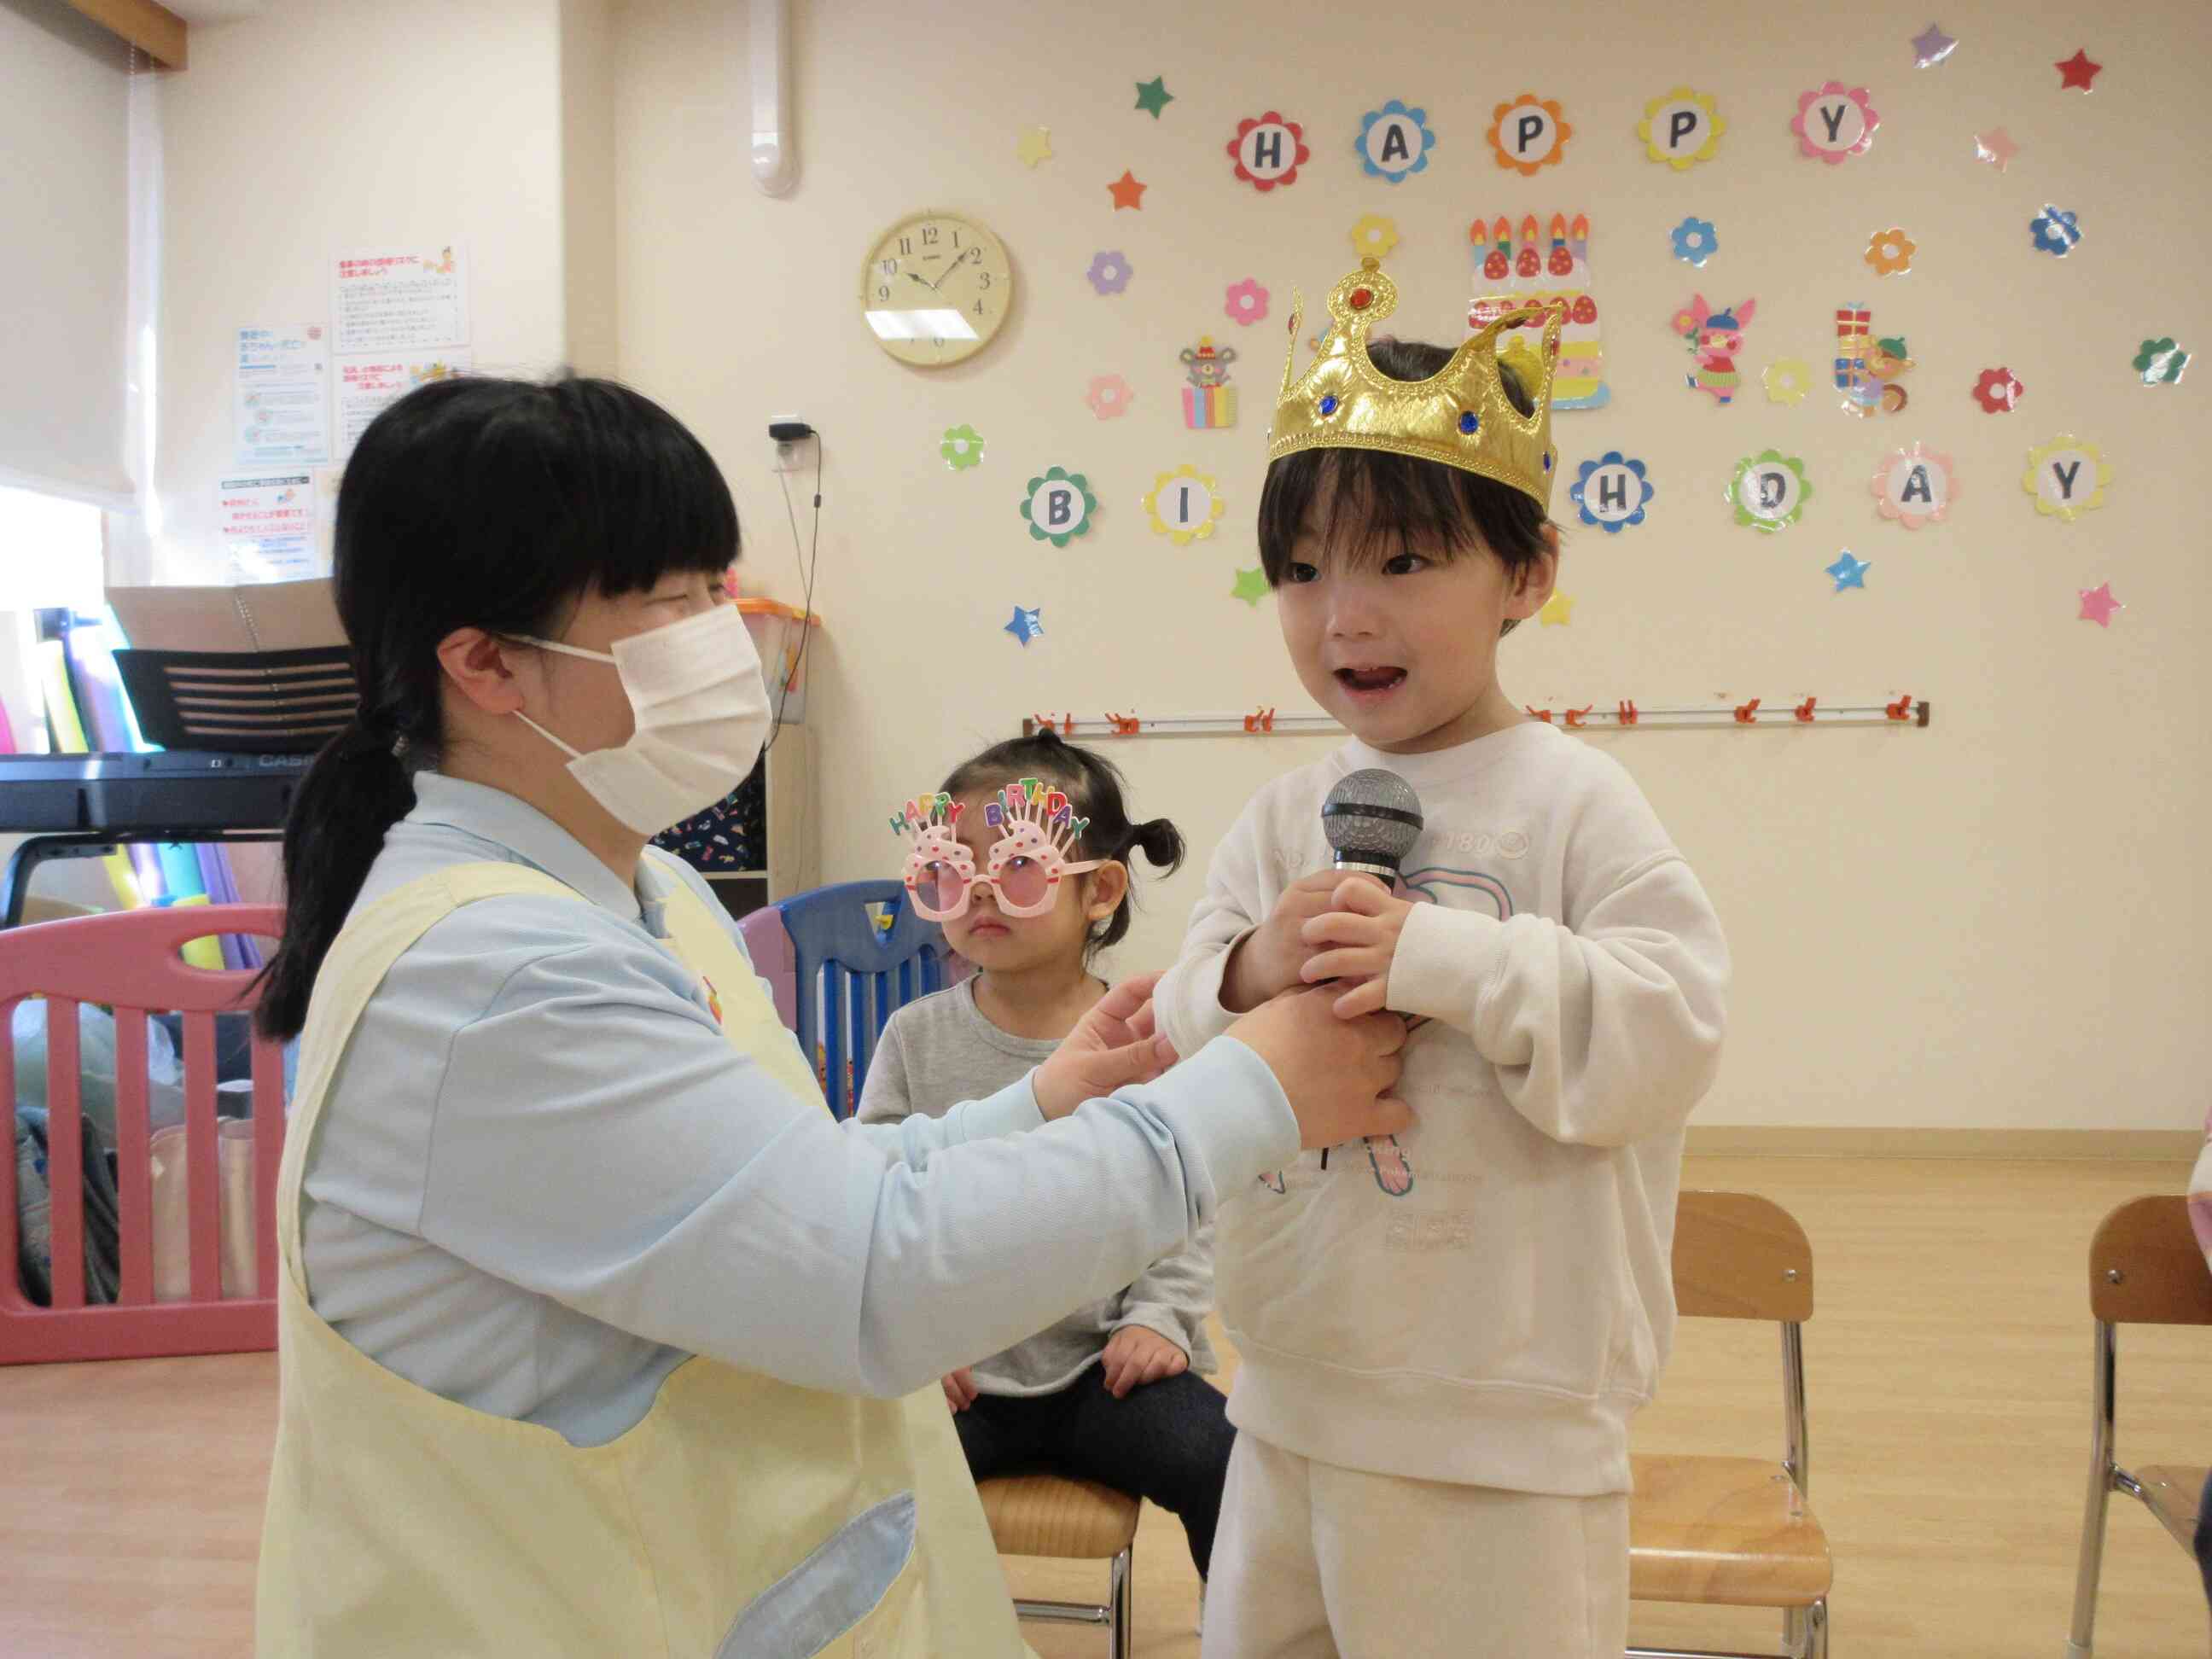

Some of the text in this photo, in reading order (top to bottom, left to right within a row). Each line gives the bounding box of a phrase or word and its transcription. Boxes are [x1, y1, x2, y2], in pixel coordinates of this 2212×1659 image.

[923, 227, 939, 246] 12
[952, 231, 960, 248] 1
[899, 238, 911, 255] 11
[970, 247, 982, 265] 2
[882, 259, 898, 274] 10
[979, 272, 990, 290] 3
[878, 286, 890, 301] 9
[973, 300, 983, 315] 4
[259, 754, 314, 767] CASI
[888, 792, 967, 836] HAPPY
[984, 777, 1091, 841] BIRTHDAY
